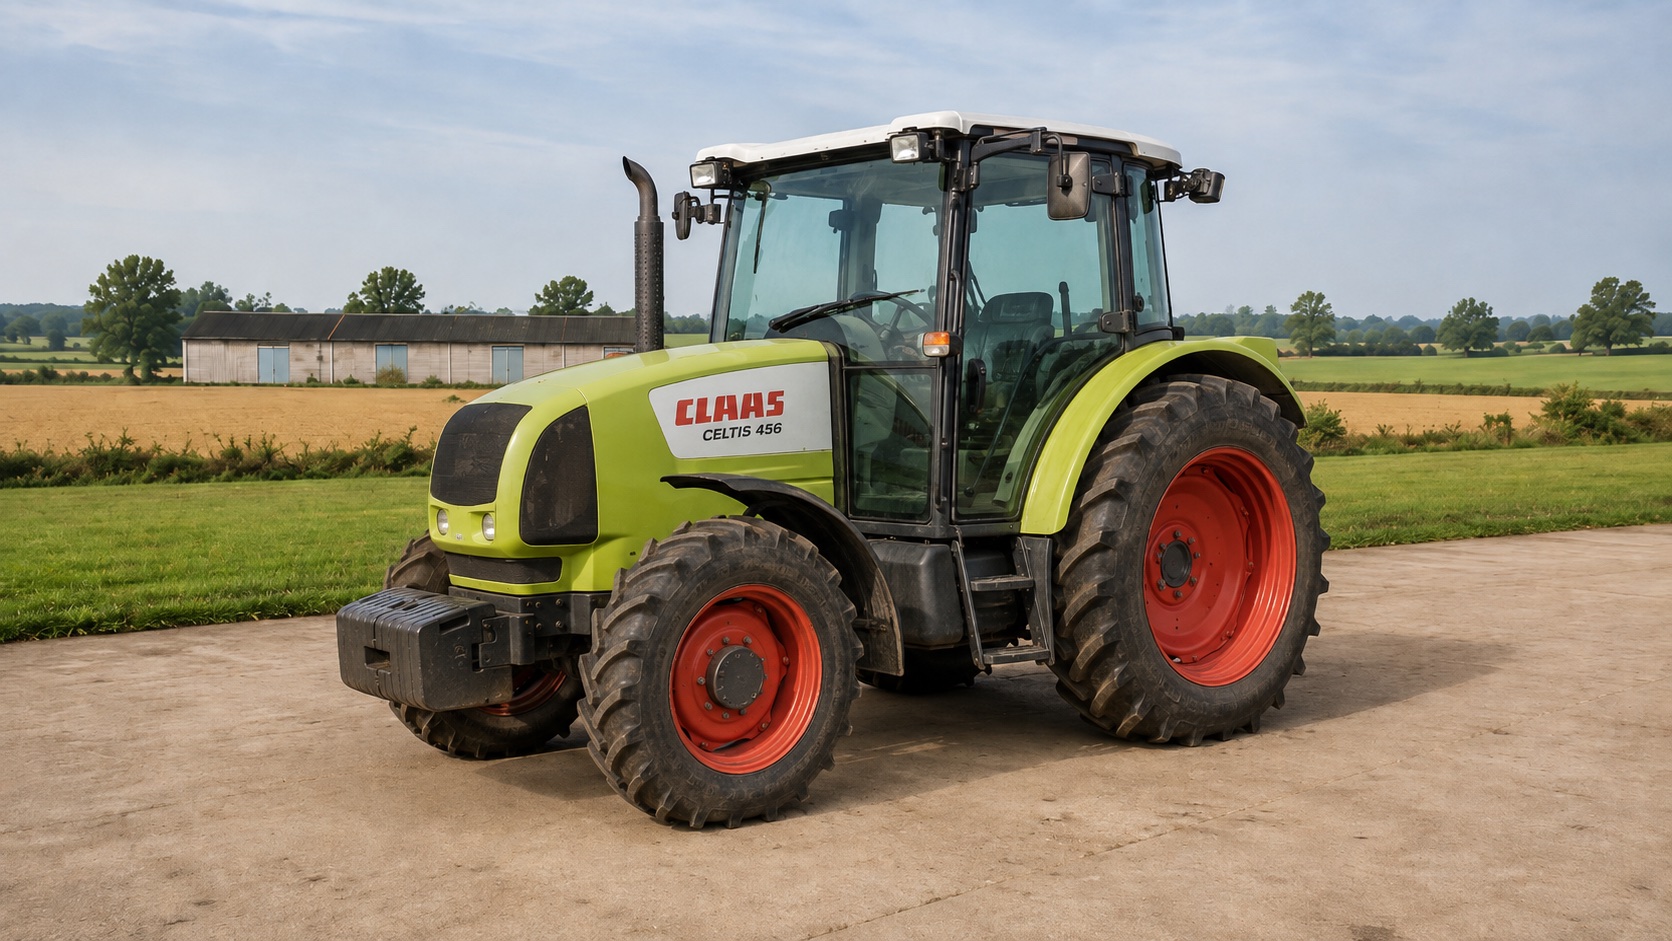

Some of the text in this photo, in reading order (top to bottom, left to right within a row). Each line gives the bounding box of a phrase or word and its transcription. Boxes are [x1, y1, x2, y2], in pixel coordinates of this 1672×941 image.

[675, 390, 784, 426] CLAAS
[703, 423, 782, 441] CELTIS 456
